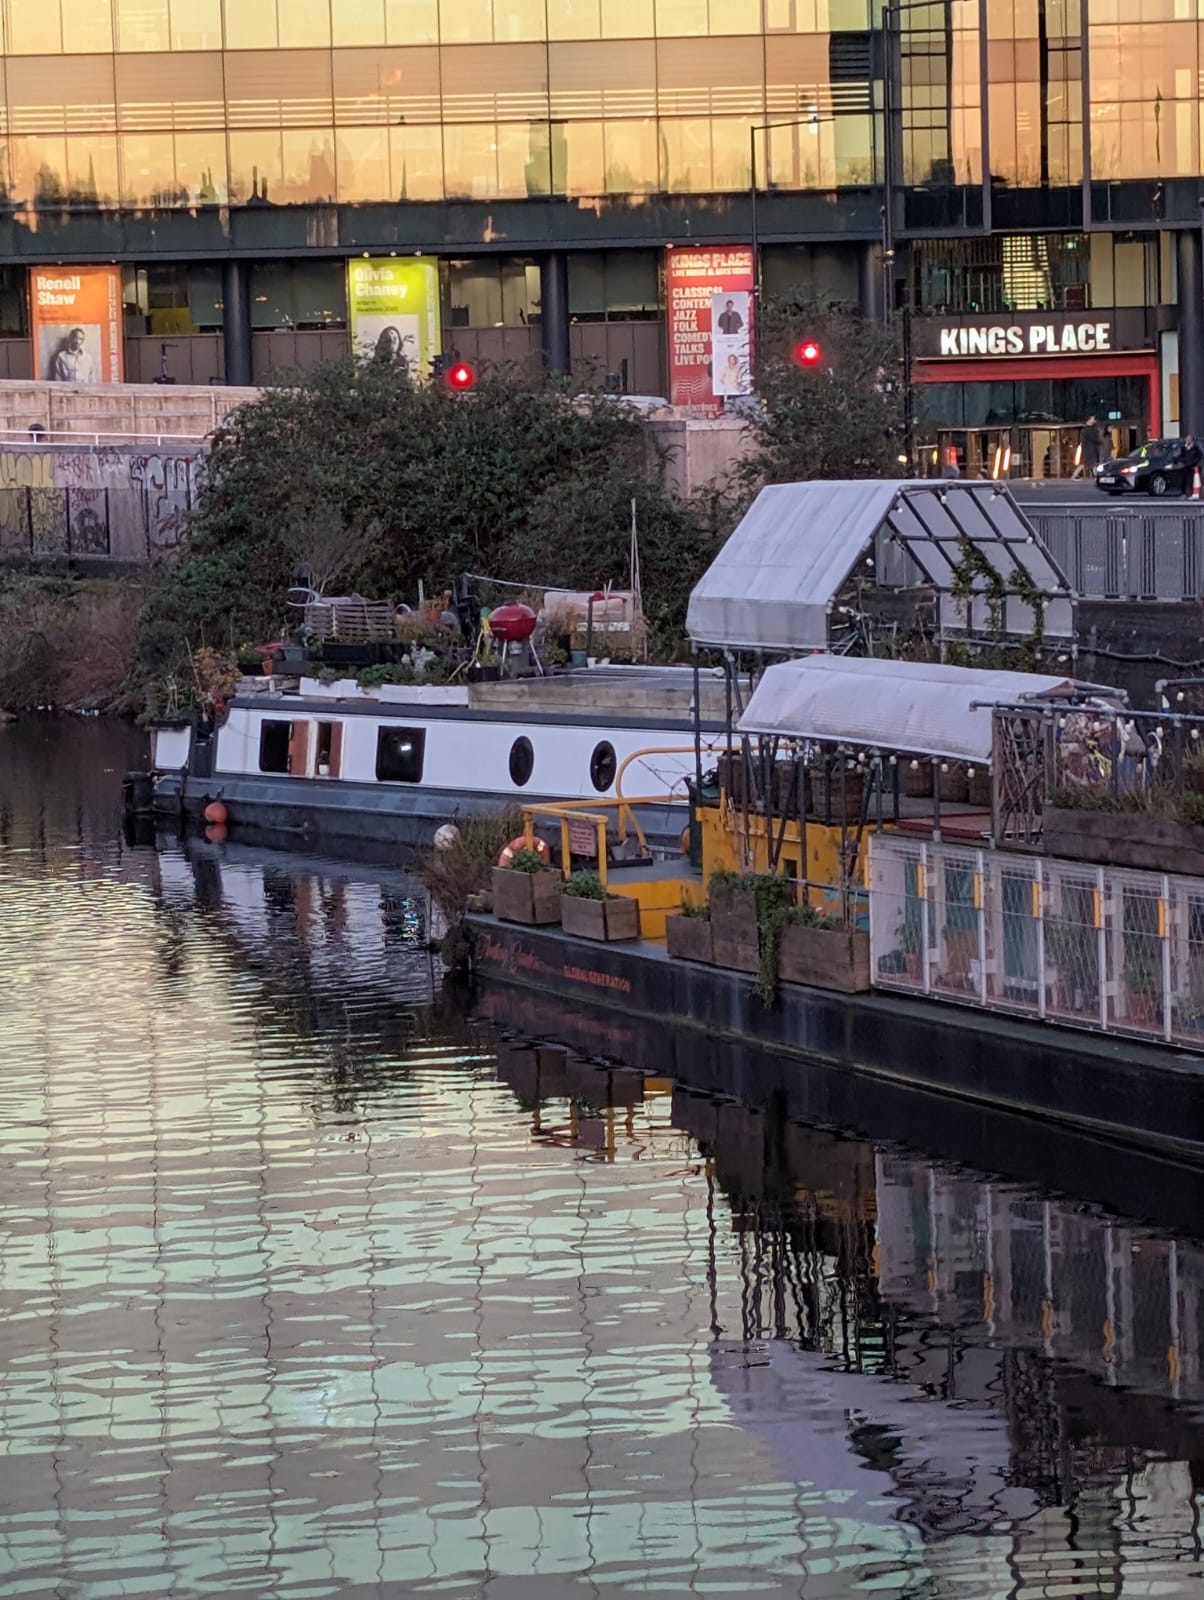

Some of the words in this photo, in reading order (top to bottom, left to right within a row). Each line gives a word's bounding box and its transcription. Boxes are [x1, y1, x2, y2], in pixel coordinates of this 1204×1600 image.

[671, 254, 711, 269] KINGS
[712, 252, 752, 268] PLACE
[355, 266, 394, 281] Olivia
[37, 276, 80, 290] Renell
[38, 291, 76, 305] Shaw
[356, 283, 408, 299] Chaney
[673, 310, 697, 321] JAZZ
[673, 321, 698, 332] FOLK
[940, 326, 1024, 355] KINGS
[1029, 323, 1111, 352] PLACE
[674, 343, 705, 354] TALKS
[675, 354, 695, 366] LIVE
